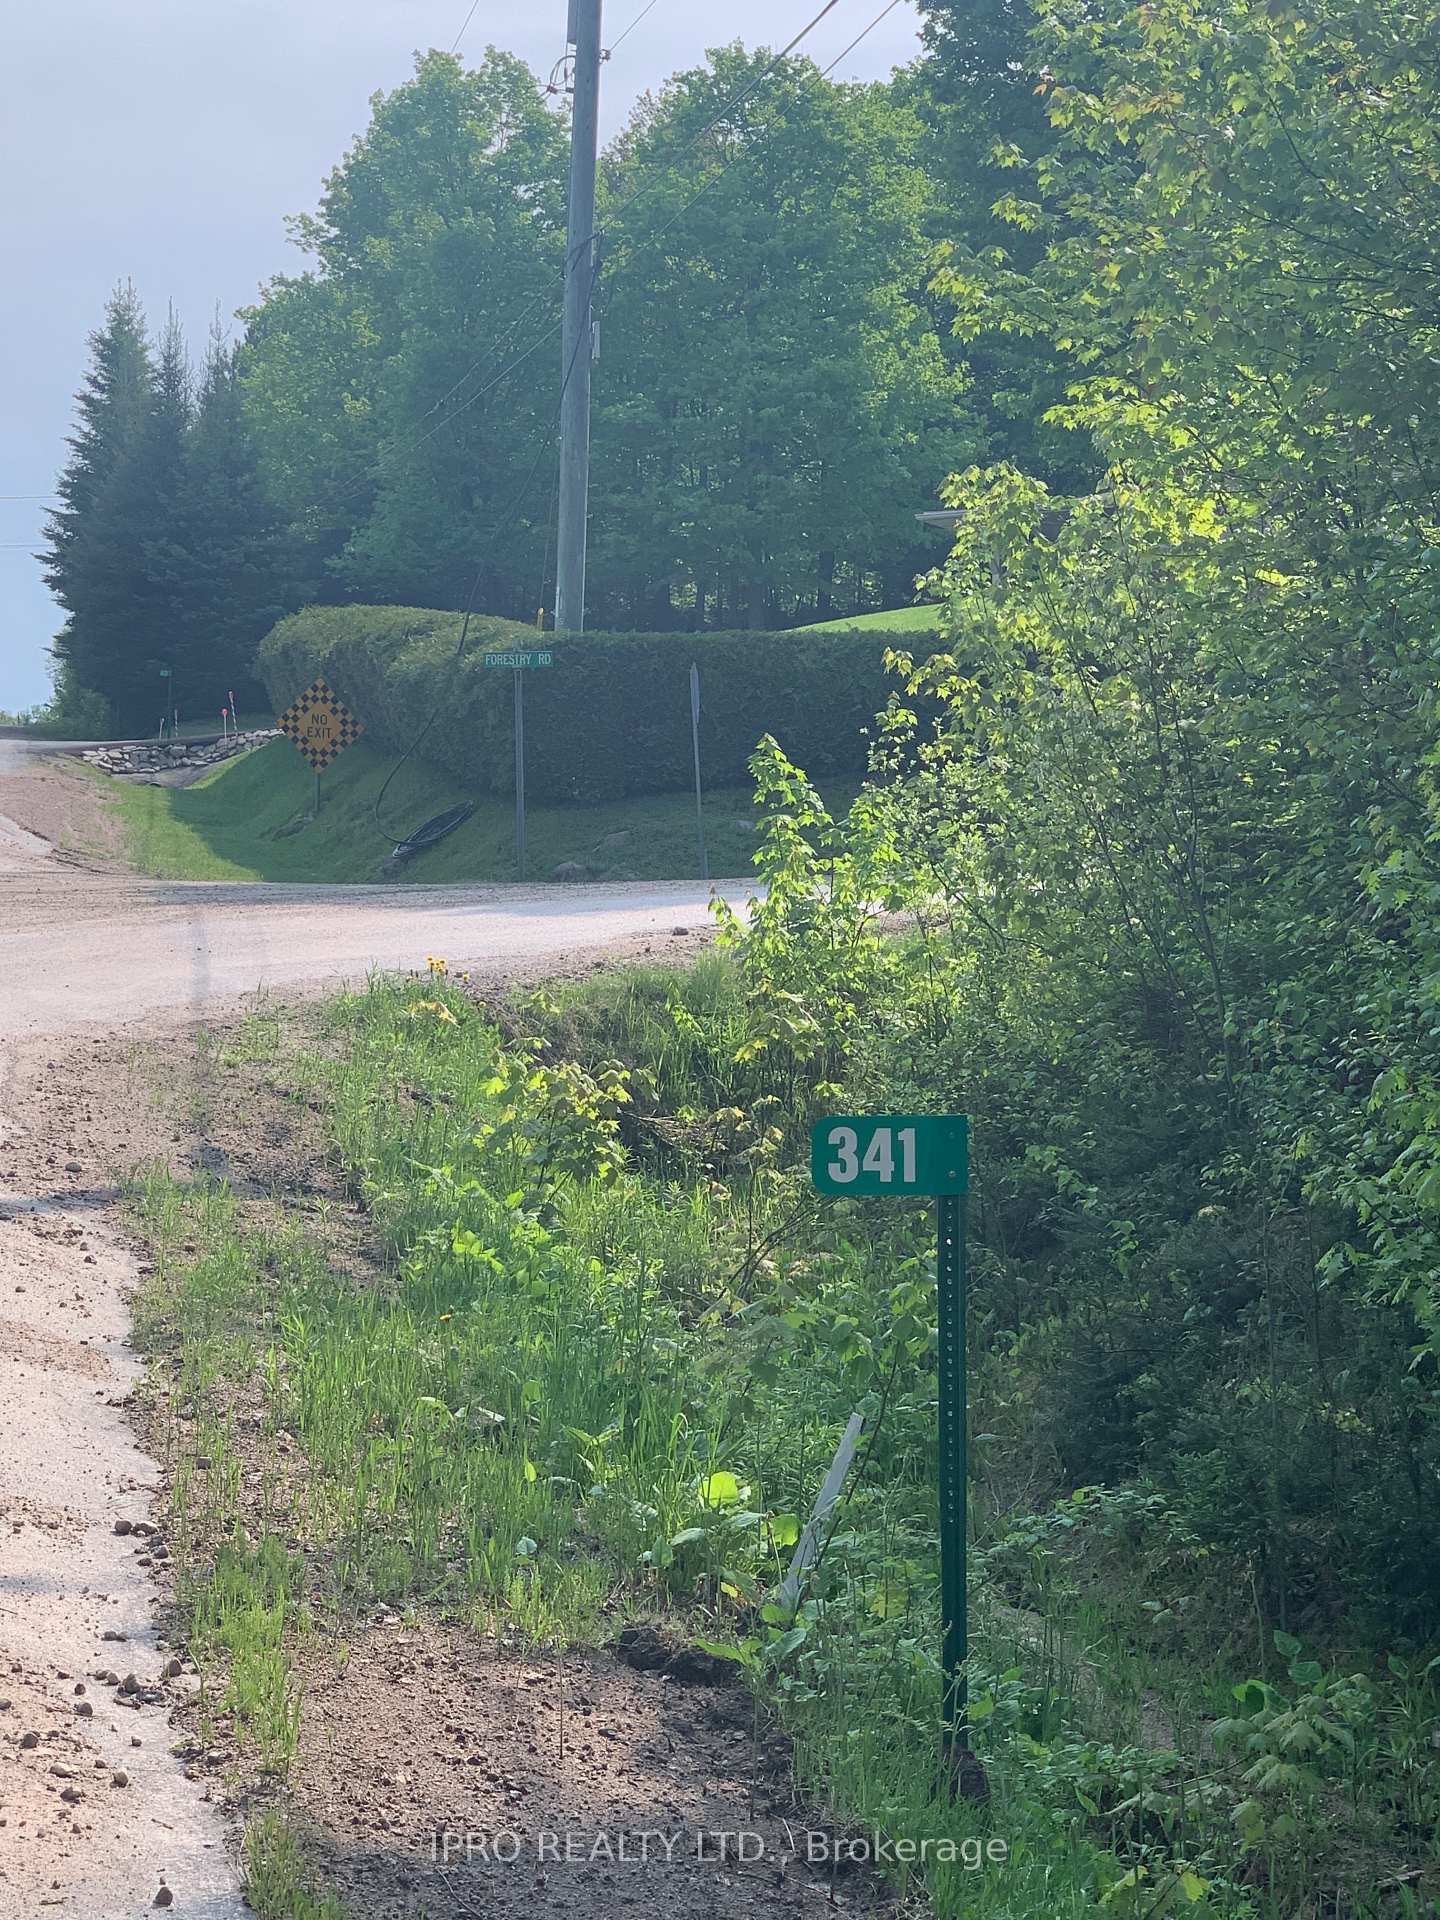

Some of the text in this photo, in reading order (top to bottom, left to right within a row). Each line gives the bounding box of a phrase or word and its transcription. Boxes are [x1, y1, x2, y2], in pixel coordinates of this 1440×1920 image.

[485, 653, 551, 665] FORESTRY RD
[311, 714, 327, 725] NO
[307, 727, 332, 738] EXIT
[828, 1126, 916, 1183] 341
